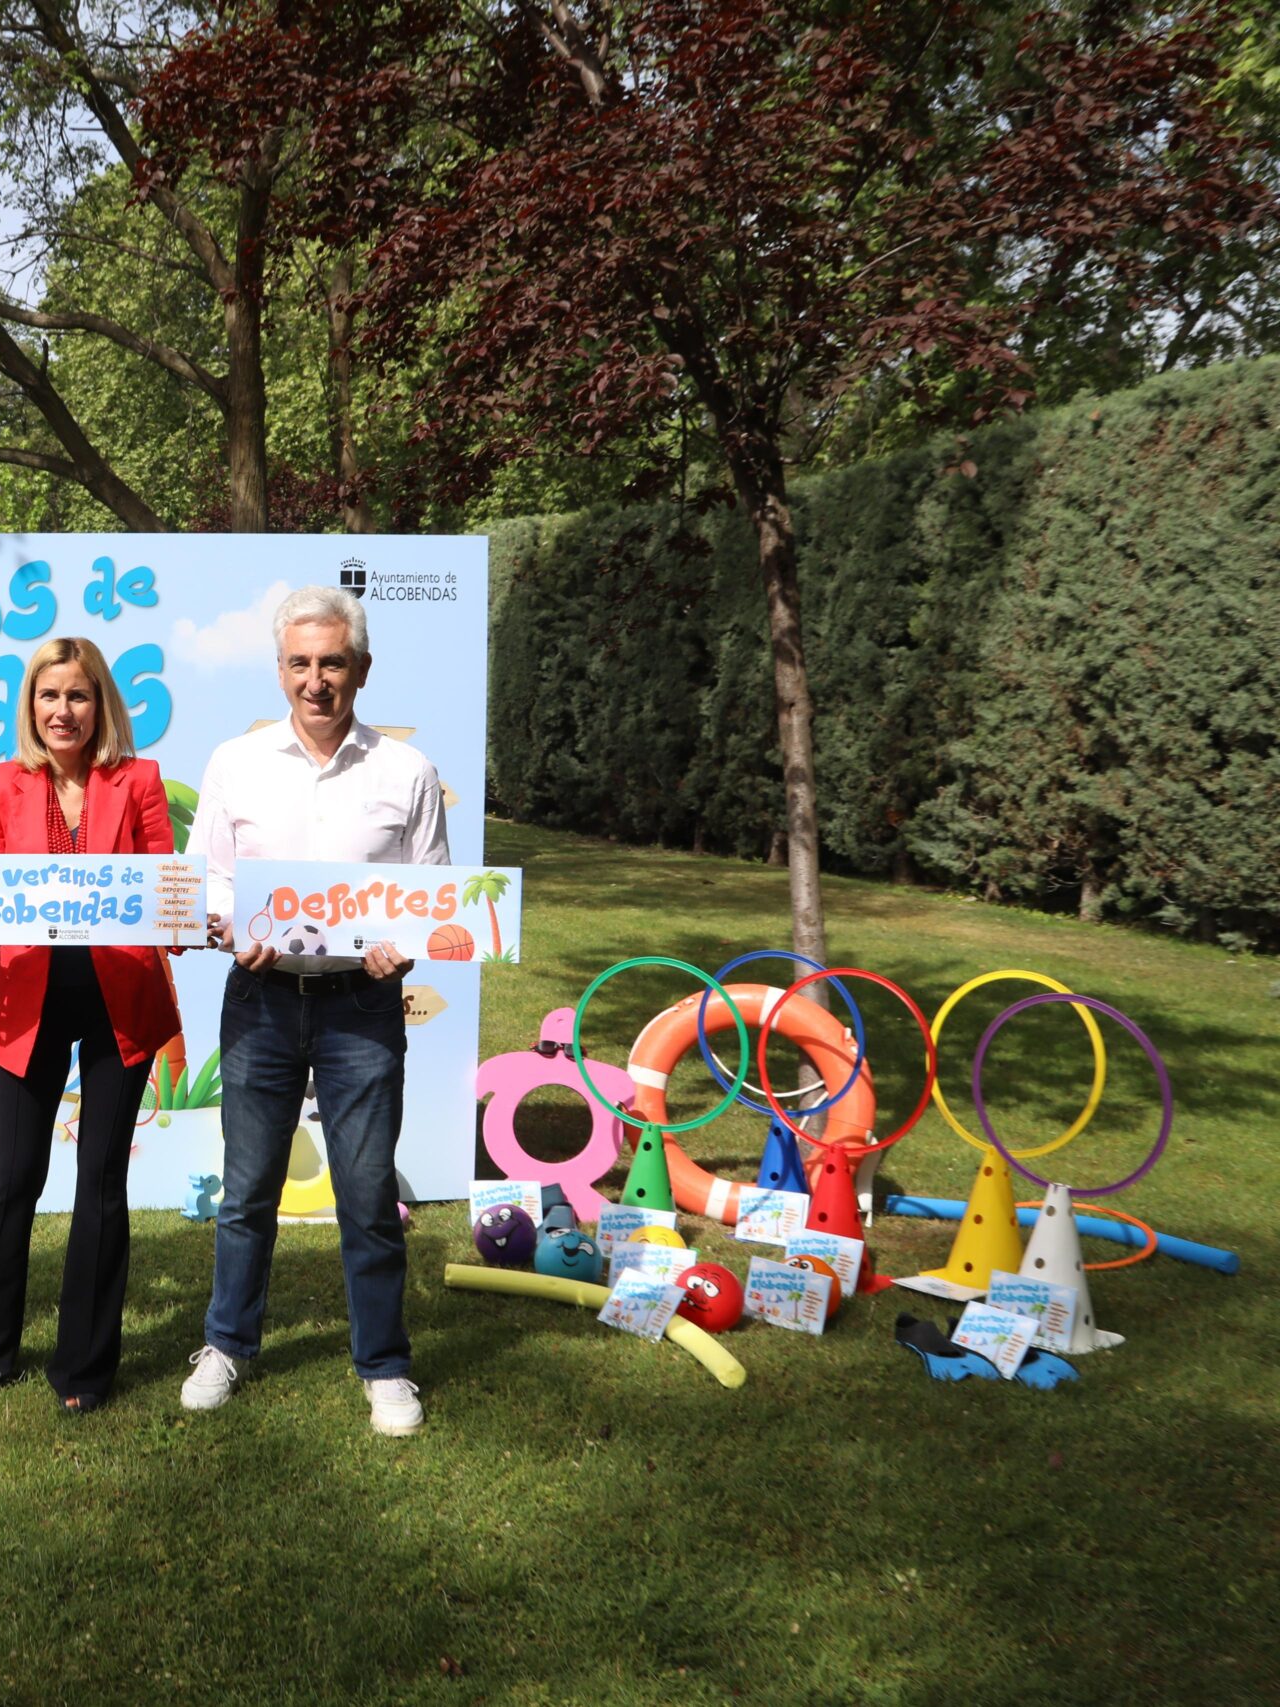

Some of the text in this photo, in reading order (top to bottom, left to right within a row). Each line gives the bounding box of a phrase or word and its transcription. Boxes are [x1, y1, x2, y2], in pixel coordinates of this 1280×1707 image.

[84, 556, 158, 621] de
[371, 571, 457, 587] Ayuntamiento de
[371, 585, 457, 601] ALCOBENDAS
[121, 867, 143, 886] de
[273, 881, 456, 927] Deportes
